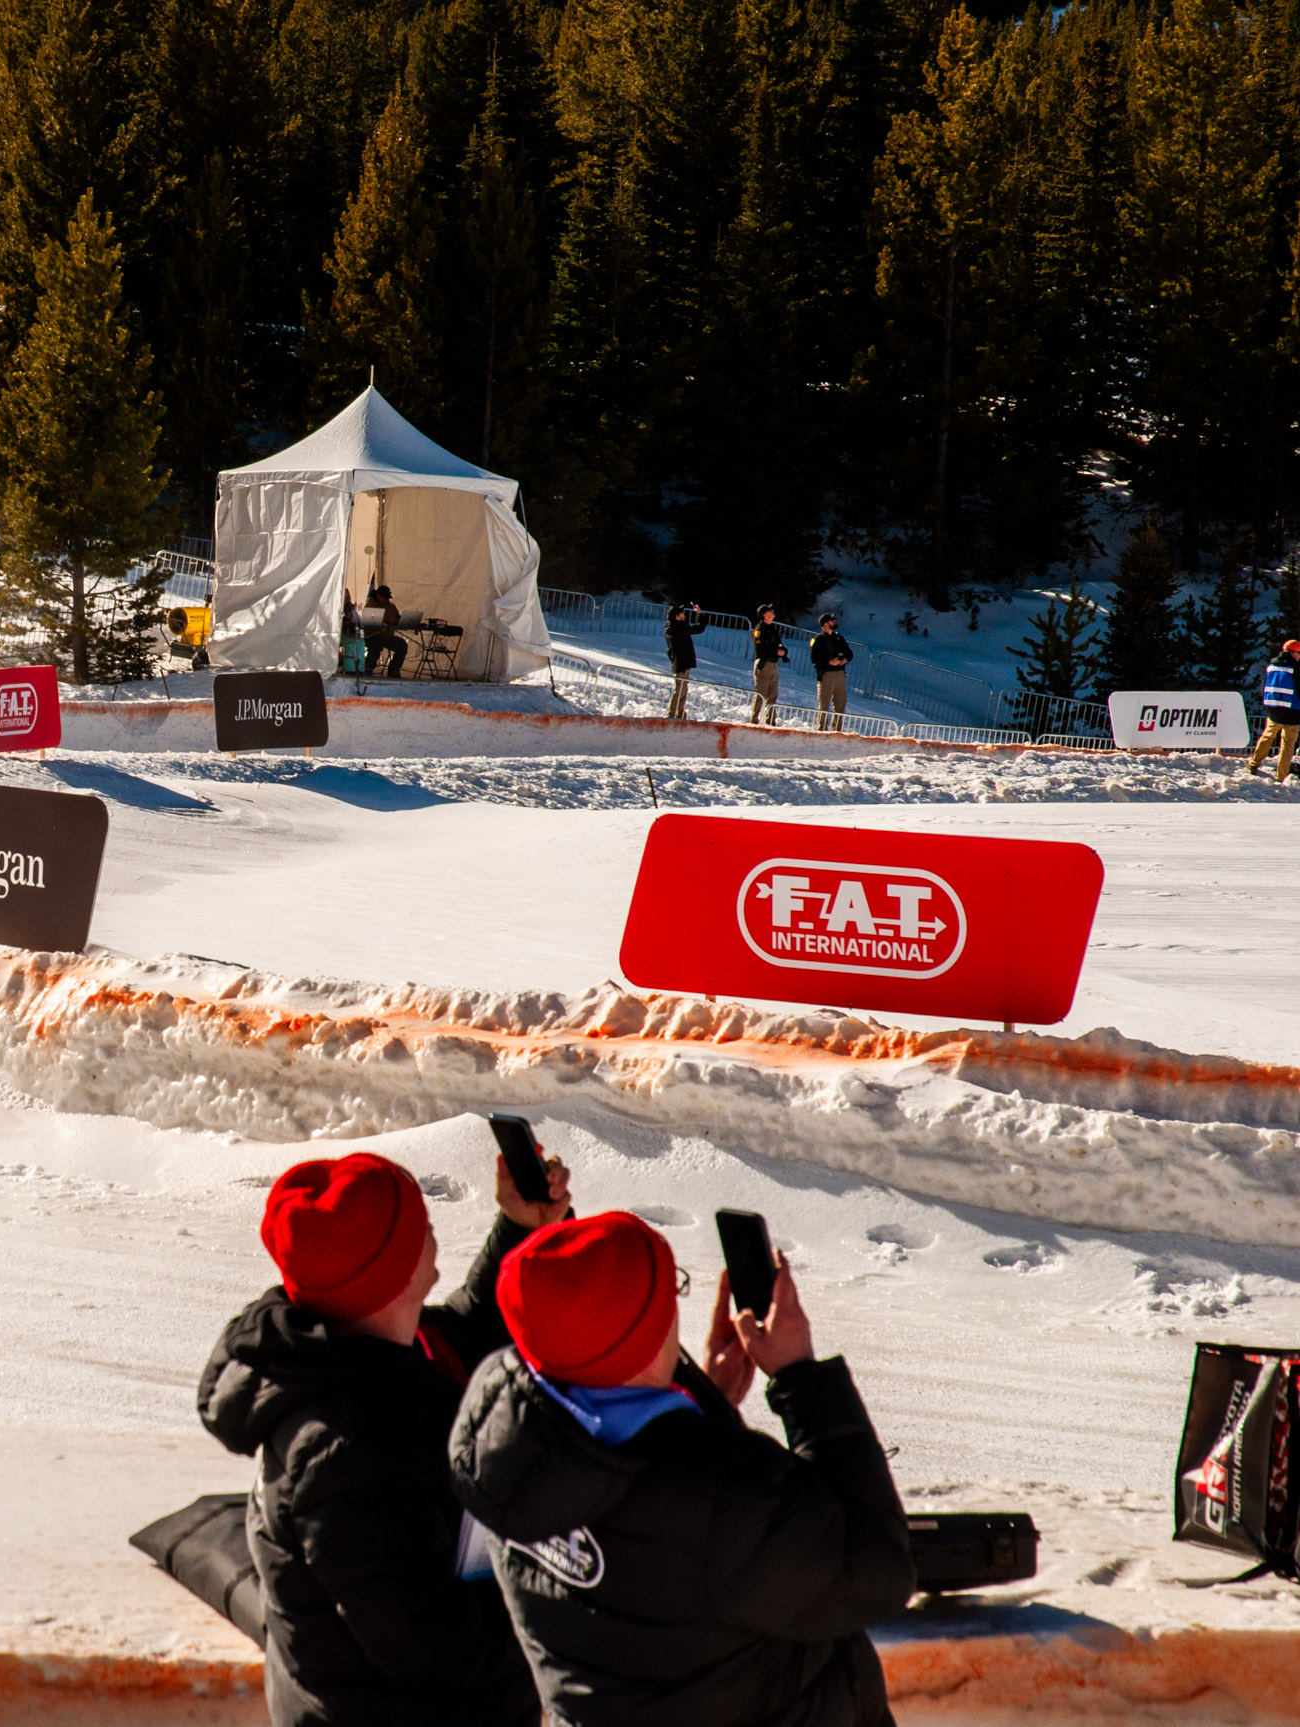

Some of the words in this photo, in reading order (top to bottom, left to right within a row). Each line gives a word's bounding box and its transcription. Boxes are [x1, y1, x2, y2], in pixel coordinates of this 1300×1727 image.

[234, 698, 303, 727] J.P.Morgan
[772, 874, 937, 940] F.A.T.
[771, 931, 934, 963] INTERNATIONAL
